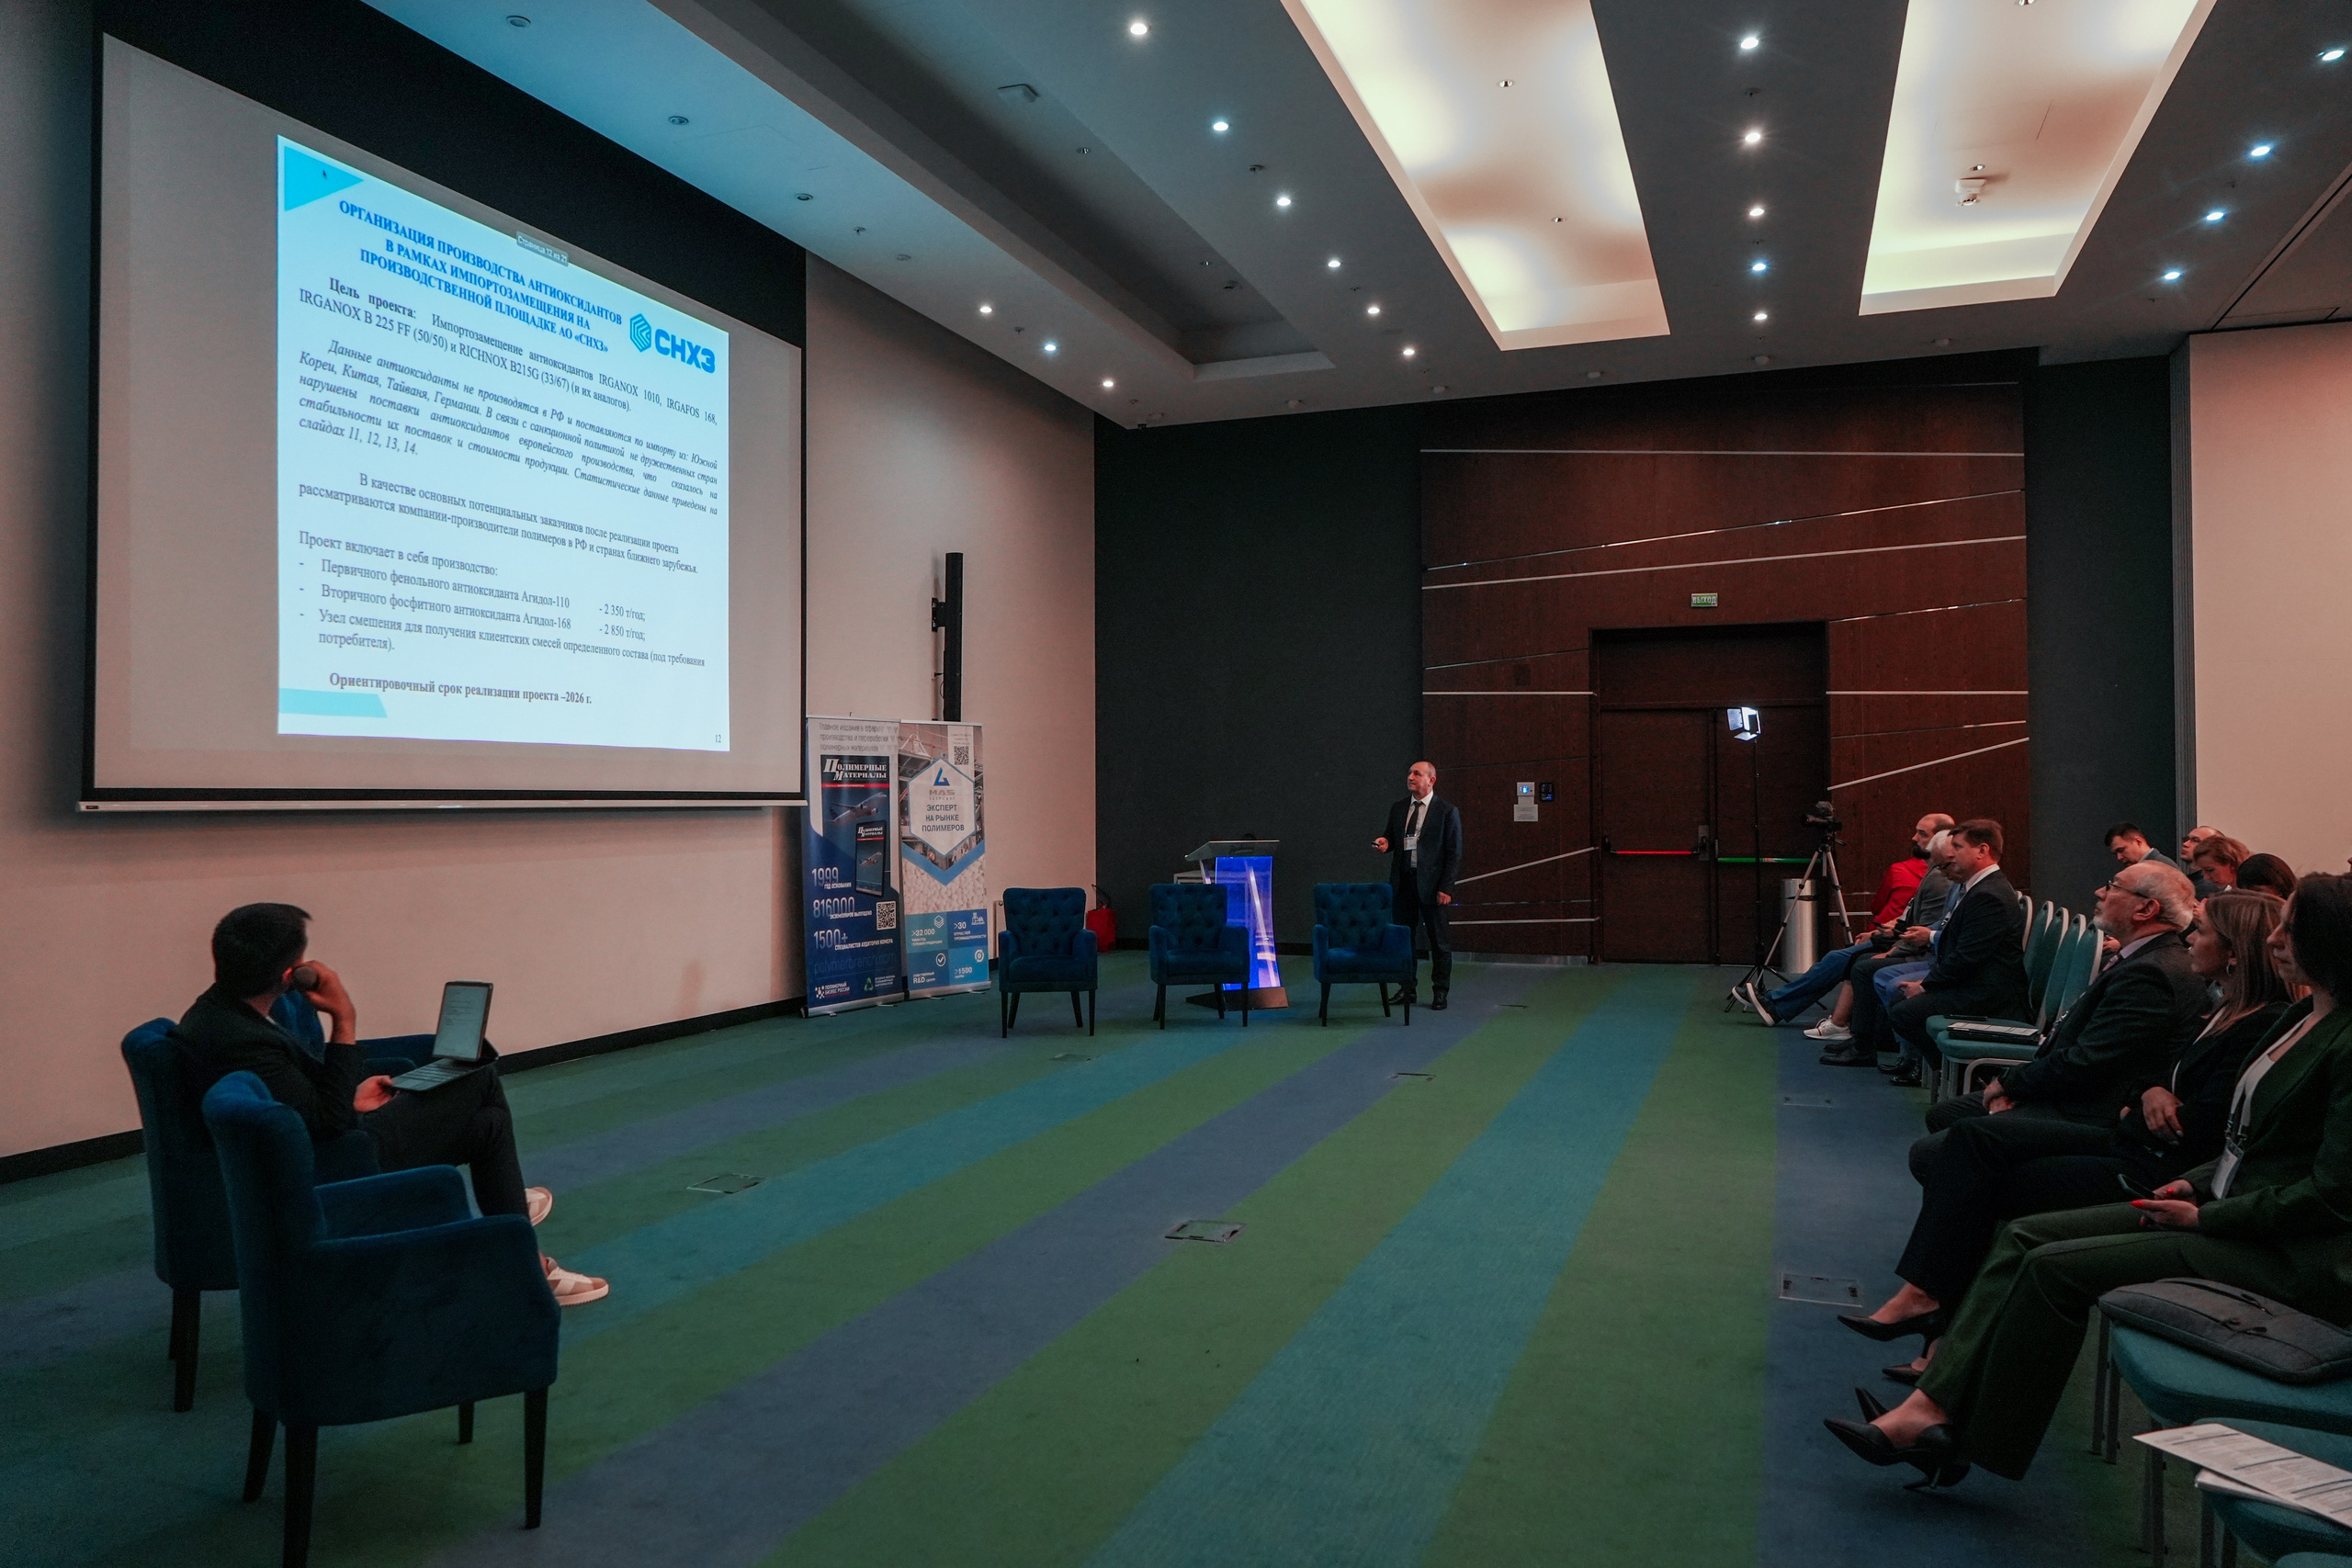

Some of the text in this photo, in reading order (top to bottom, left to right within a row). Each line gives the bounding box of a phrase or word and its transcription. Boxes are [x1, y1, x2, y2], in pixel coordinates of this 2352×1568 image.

[339, 200, 623, 325] ОРГАНИЗАЦИЯ ПРОИЗВОДСТВА АНТИОКСИДАНТОВ
[547, 247, 553, 258] 12
[360, 248, 492, 310] ПРОИЗВОДСТВЕННОЙ
[494, 299, 557, 334] ПЛОЩАДКЕ
[559, 326, 573, 340] АО
[385, 238, 591, 331] В РАМКАХ ИМПОРТОЗАМЕЩЕНИЯ НА
[300, 288, 362, 321] IRGANOX
[375, 314, 394, 332] 225
[396, 321, 412, 337] FF
[413, 327, 448, 353] (50/50)
[449, 343, 458, 354] и
[458, 342, 508, 370] RICHNOX
[509, 359, 539, 380] B215G
[540, 371, 571, 393] (33/67)
[571, 381, 580, 395] (и
[581, 387, 592, 399] их
[593, 391, 632, 412] аналогов).
[329, 276, 718, 426] Цель проекта: Импортозамещение антиоксидантов IRGANOX 1010, IRGAFOS 168,
[655, 328, 716, 374] СНХЗ
[299, 351, 718, 485] Кореи, Китая, Тайваня, Германии. В связи с санкционной политикой не дружественных стран
[327, 339, 718, 470] Данные антиоксиданты не производятся в РФ и поставляются по импорту из: Южной
[299, 418, 418, 456] слайдах 11, 12, 13, 14.
[299, 375, 718, 501] нарушены поставки антиоксидантов европейского производства, что сказалось на
[299, 397, 718, 515] стабильности их поставок и стоимости продукции. Статистические данные приведены на
[299, 483, 698, 574] рассматриваются компании-производители полимеров в РФ и странах ближнего зарубежья.
[359, 472, 680, 555] В качестве основных потенциальных заказчиков после реализации проекта
[299, 530, 498, 577] Проект включает в себя производство:
[321, 558, 646, 623] Первичного фенольного антиоксиданта Агидол-110 2 350 т/год;
[321, 583, 646, 642] Вторичного фосфитного антиоксиданта Агидол-168 2 850 т/год;
[1692, 596, 1716, 604] ВЫХОД
[318, 608, 346, 625] Узел
[403, 622, 424, 634] для
[424, 625, 477, 639] получения
[478, 631, 530, 646] клиентских
[531, 637, 562, 649] смесей
[562, 641, 621, 657] определенного
[621, 649, 650, 660] состава
[650, 650, 667, 663] (под
[667, 653, 706, 667] требования
[318, 632, 395, 653] потребителя).
[329, 672, 435, 693] Ориентировочный
[437, 683, 463, 697] срок
[464, 685, 521, 699] реализации
[522, 691, 560, 703] проекта
[585, 695, 593, 705] г.
[715, 734, 722, 744] 12
[823, 759, 887, 772] ПОЛИМЕРНЫЕ
[833, 771, 887, 781] МАТЕРИАЛЫ
[922, 824, 965, 832] ПОЛИМЕРОВ
[925, 814, 934, 822] НА
[926, 804, 957, 812] ЭКСПЕРТ
[812, 867, 839, 887] 1999
[813, 897, 855, 919] 816000
[813, 928, 848, 950] 1500+
